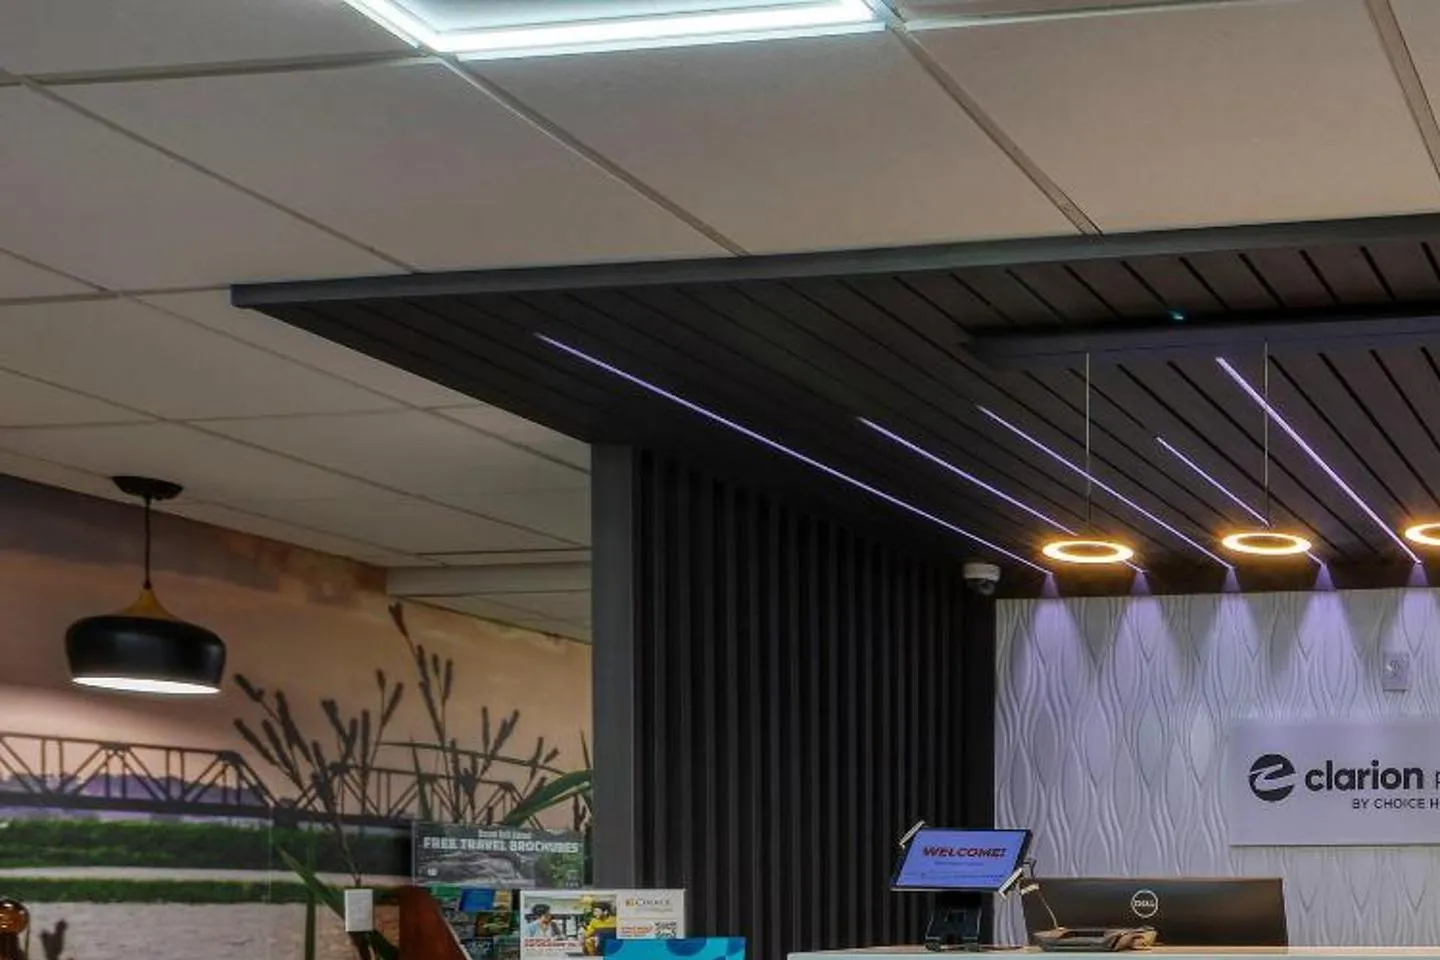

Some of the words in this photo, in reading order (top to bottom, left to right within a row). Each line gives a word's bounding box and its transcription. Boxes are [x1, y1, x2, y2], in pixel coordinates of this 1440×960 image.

[1305, 759, 1424, 792] clarion
[1352, 799, 1369, 809] BY
[1374, 798, 1425, 809] CHOICE
[423, 837, 457, 849] FREE
[460, 838, 507, 851] TRAVEL
[923, 847, 1007, 857] WELCOME!
